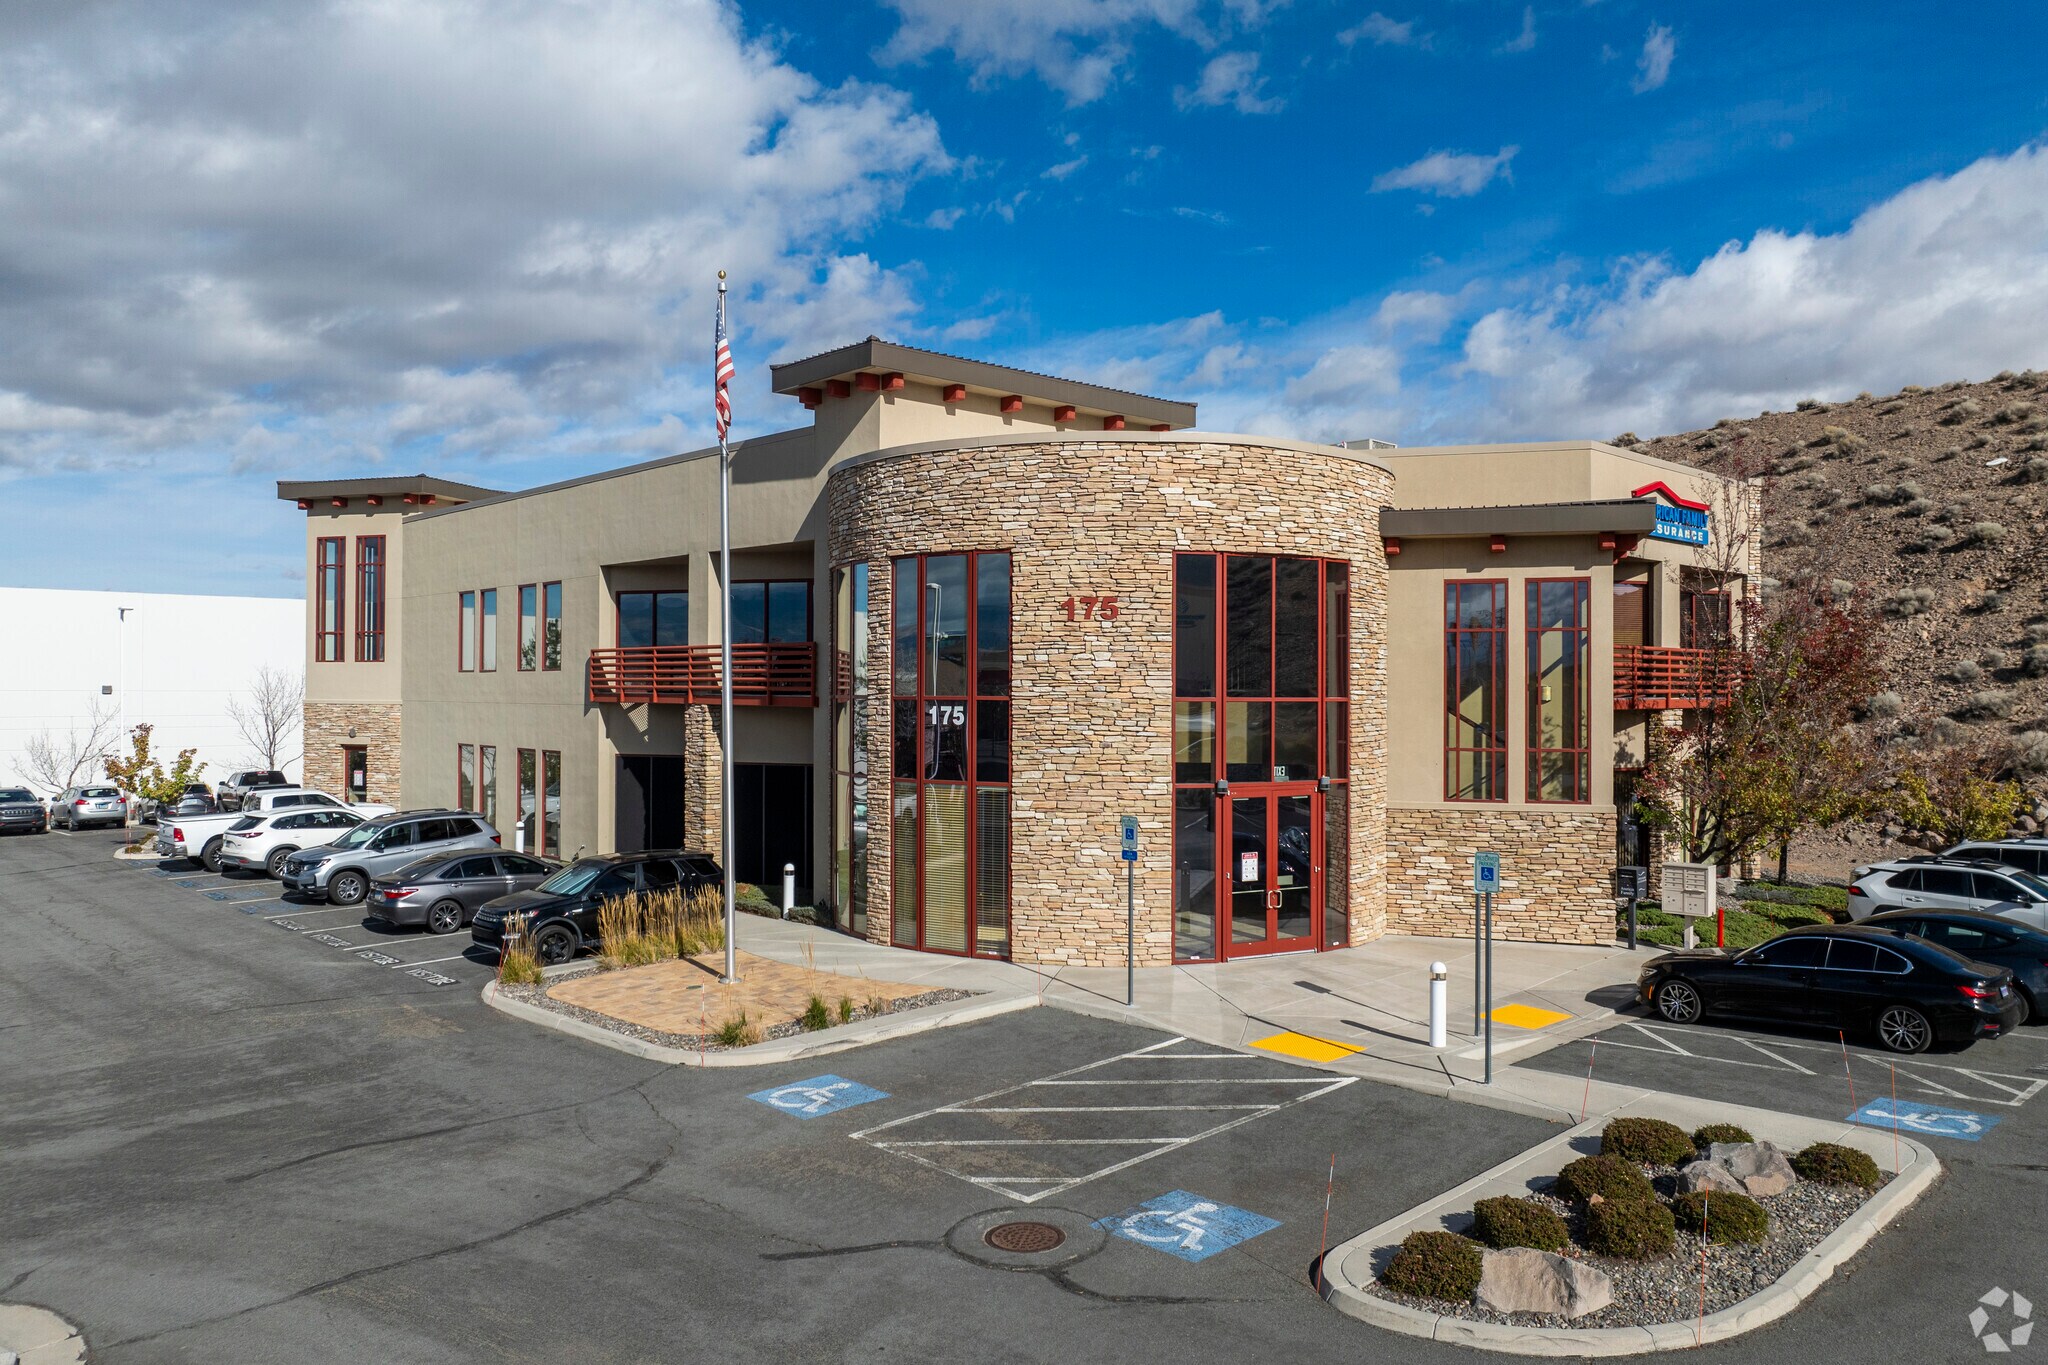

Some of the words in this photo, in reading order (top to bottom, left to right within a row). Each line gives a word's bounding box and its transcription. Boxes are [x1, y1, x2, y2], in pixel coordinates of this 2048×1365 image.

[1656, 504, 1680, 523] RICAN
[1656, 524, 1704, 541] SURANCE
[1060, 596, 1119, 621] 175
[929, 705, 965, 726] 175
[404, 967, 457, 987] VISITOR
